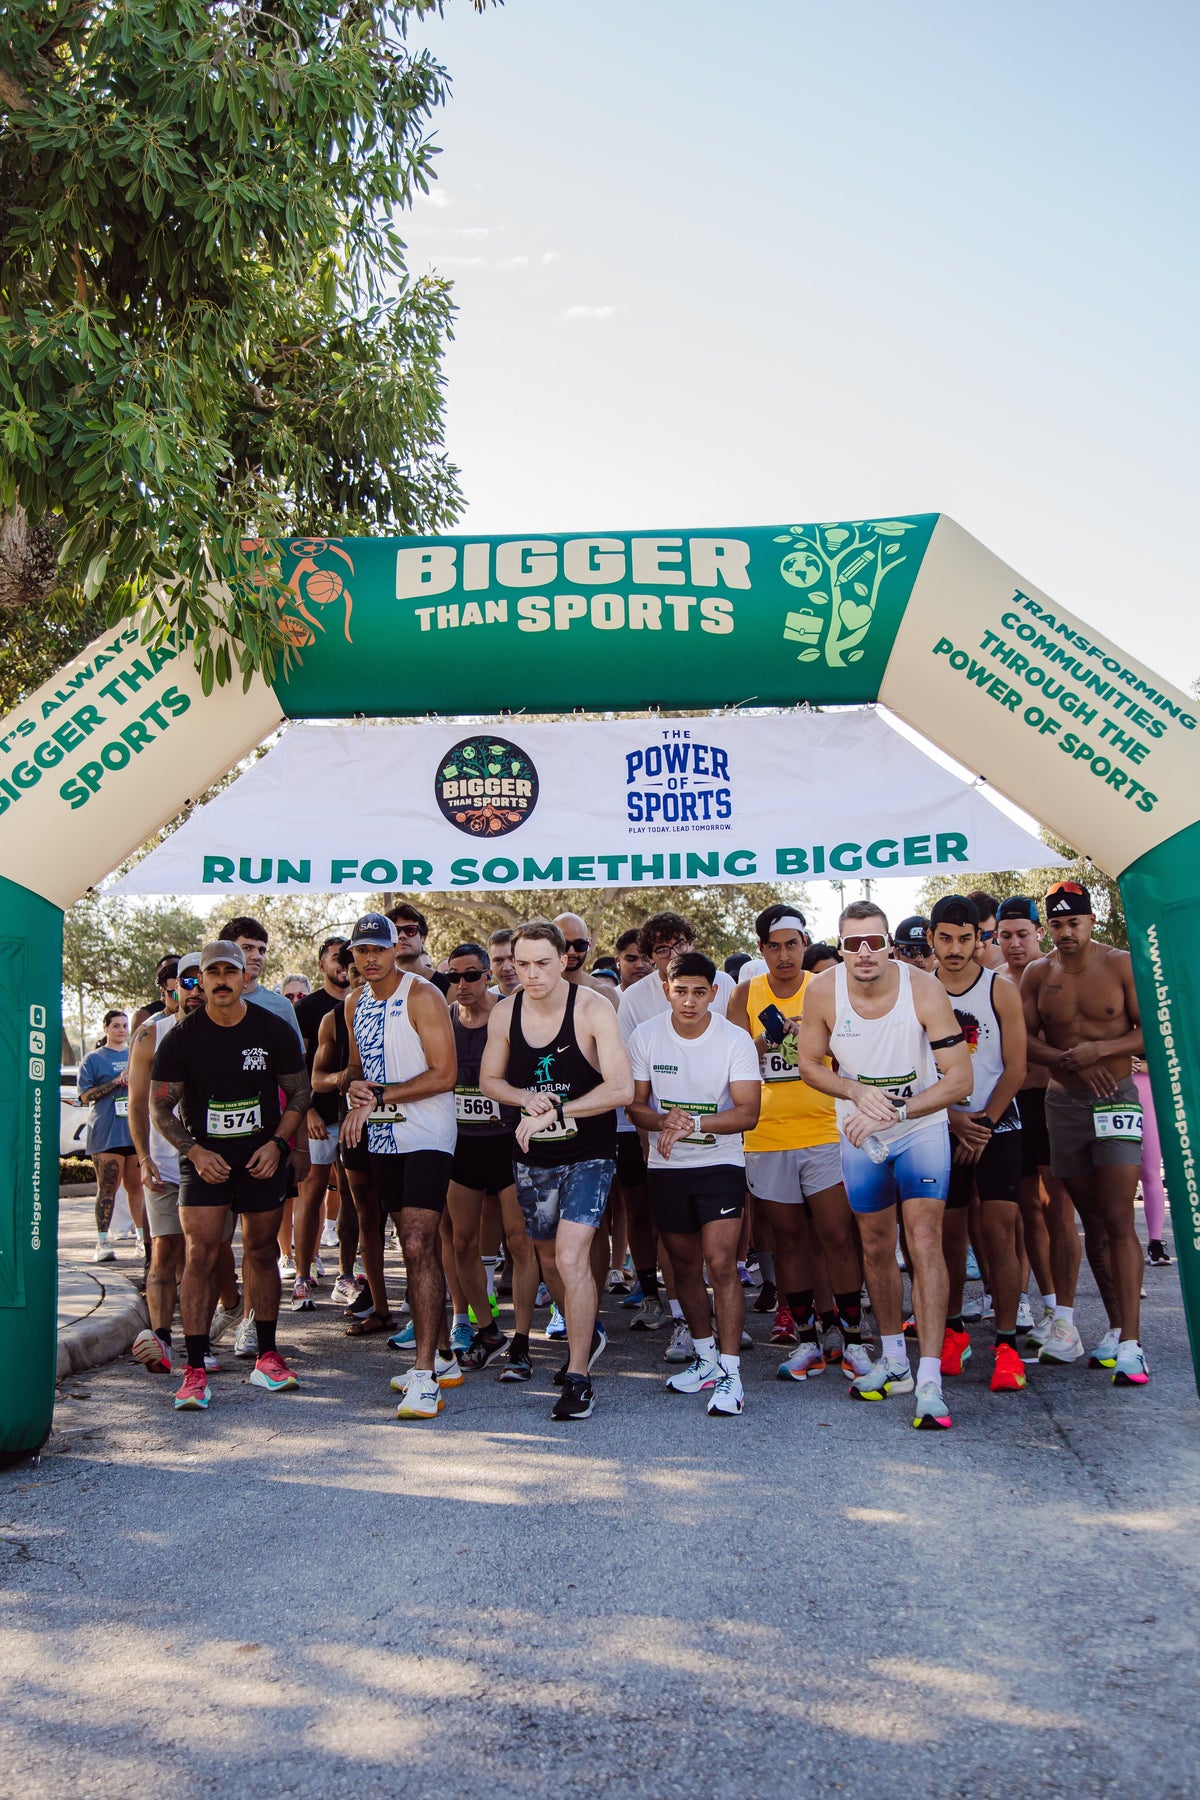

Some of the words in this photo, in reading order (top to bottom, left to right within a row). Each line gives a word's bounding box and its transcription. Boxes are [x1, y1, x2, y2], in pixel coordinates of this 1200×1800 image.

[395, 537, 752, 600] BIGGER
[414, 599, 508, 632] THAN
[517, 593, 735, 635] SPORTS
[1000, 612, 1168, 739] COMMUNITIES
[1012, 588, 1199, 731] TRANSFORMING
[0, 718, 37, 754] T'S
[40, 628, 139, 720] ALWAYS
[979, 629, 1099, 727] THROUGH
[1098, 717, 1151, 766] THE
[662, 730, 691, 739] THE
[931, 636, 1023, 713] POWER
[1023, 706, 1062, 736] OF
[1057, 732, 1159, 813] SPORTS
[59, 685, 191, 810] SPORTS
[625, 743, 731, 785] POWER
[442, 778, 532, 799] BIGGER
[448, 798, 472, 807] THAN
[473, 797, 527, 808] SPORTS
[667, 777, 688, 790] OF
[627, 788, 732, 822] SPORTS
[202, 855, 311, 884] RUN
[330, 858, 434, 886] FOR
[450, 850, 757, 885] SOMETHING
[775, 832, 970, 875] BIGGER
[360, 922, 379, 930] SAC
[540, 1083, 571, 1092] DELRAY
[885, 1085, 913, 1098] 74
[223, 1110, 256, 1129] 574
[463, 1099, 493, 1115] 569
[1112, 1115, 1142, 1130] 674
[31, 1088, 42, 1250] @biggerthansportsco
